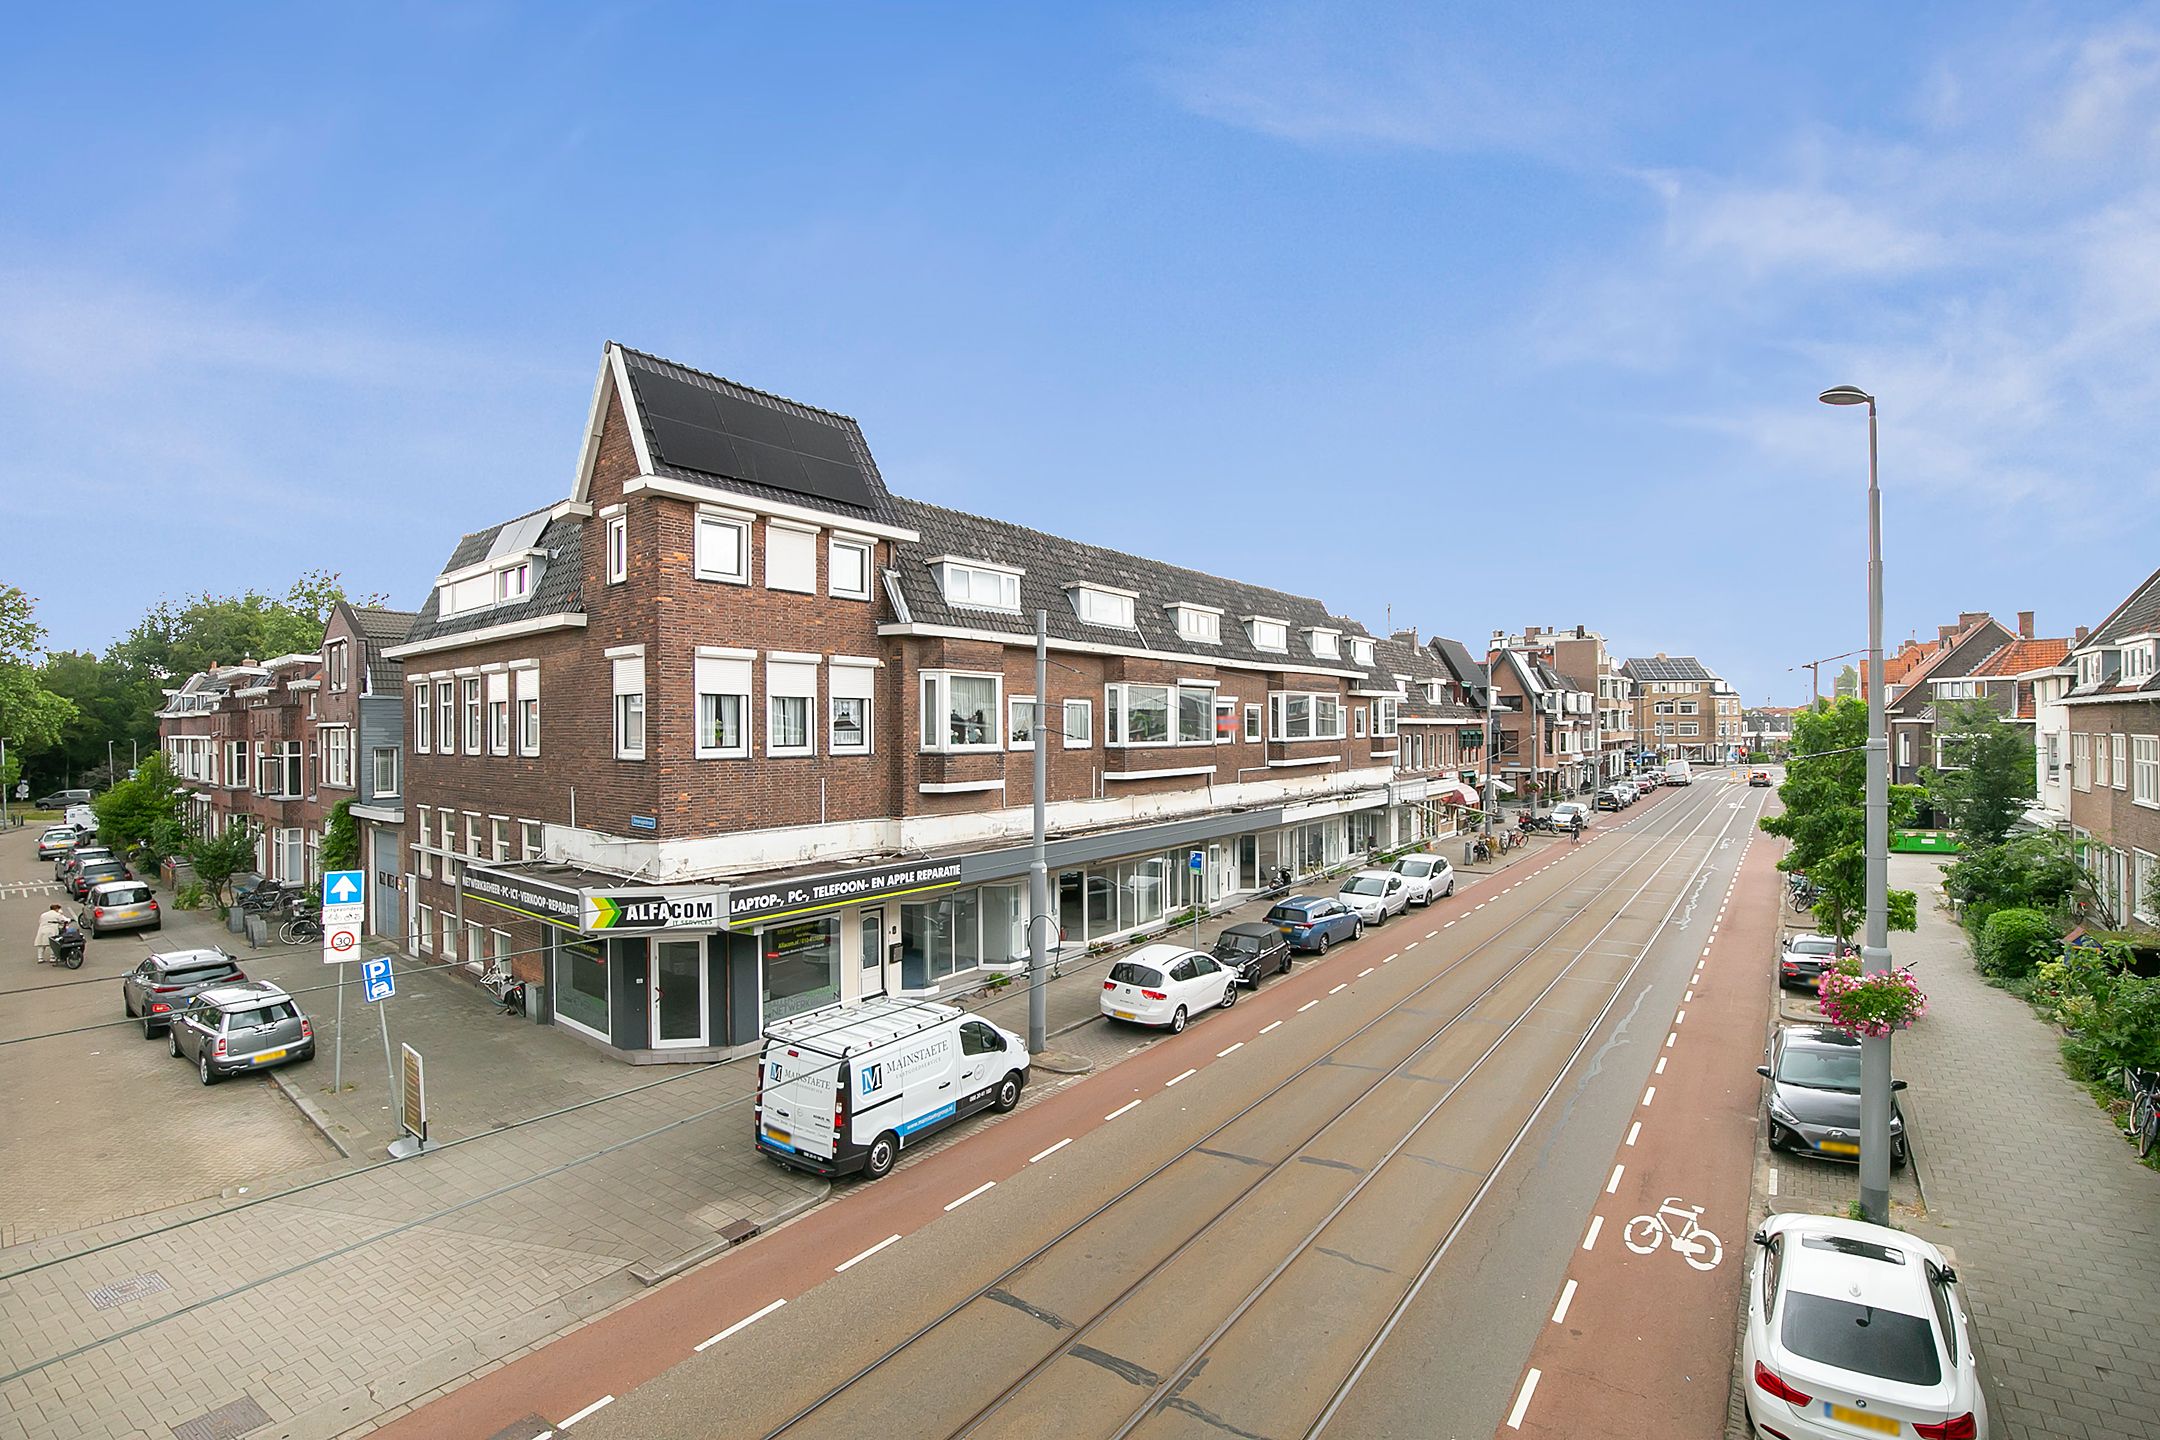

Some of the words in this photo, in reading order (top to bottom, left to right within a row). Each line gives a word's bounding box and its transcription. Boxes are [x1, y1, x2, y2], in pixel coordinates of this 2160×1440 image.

[813, 879, 870, 897] TELEFOON-
[871, 876, 885, 888] EN
[886, 871, 915, 886] APPLE
[916, 864, 961, 881] REPARATIE
[626, 902, 713, 921] ALFACOM
[335, 937, 351, 947] 30
[369, 961, 386, 983] P
[886, 1040, 949, 1075] MAINSTAETE
[784, 1069, 831, 1090] MAINSTAETE
[862, 1065, 881, 1092] M
